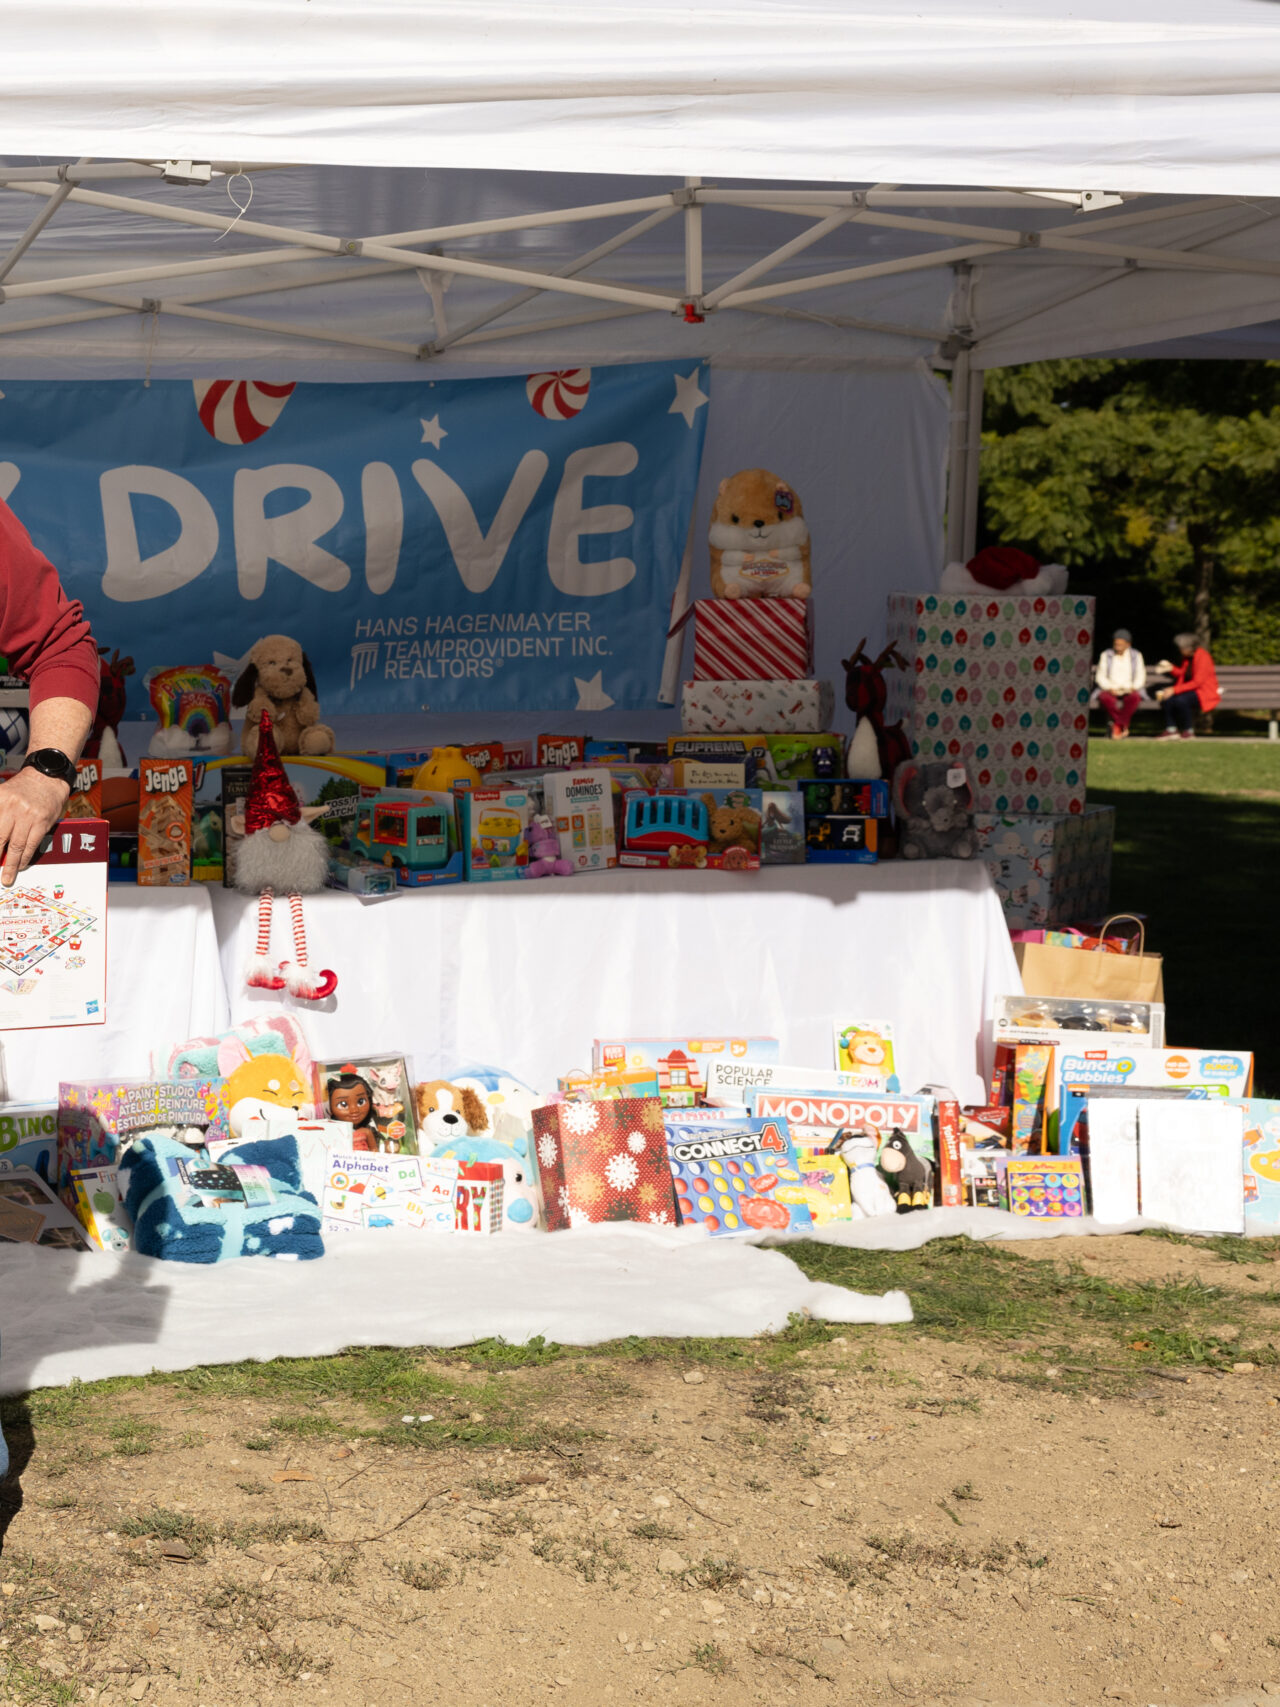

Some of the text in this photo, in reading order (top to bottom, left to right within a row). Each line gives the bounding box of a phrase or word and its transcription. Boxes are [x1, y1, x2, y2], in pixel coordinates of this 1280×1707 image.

[99, 440, 638, 603] DRIVE
[355, 611, 592, 638] HANS HAGENMAYER
[384, 636, 614, 660] TEAMPROVIDENT INC.
[541, 741, 579, 766] Jenga
[674, 741, 745, 752] SUPREME
[145, 764, 187, 792] Jenga
[566, 783, 603, 798] DOMINOES
[715, 1064, 773, 1079] POPULAR
[1063, 1070, 1124, 1084] Bubbles
[717, 1074, 771, 1087] SCIENCE
[127, 1085, 195, 1102] PAINT STUDIO
[119, 1098, 206, 1116] ATELIER PEINTURE
[762, 1096, 918, 1129] MONOPOLY
[117, 1114, 157, 1130] ESTUDIO
[167, 1111, 209, 1124] PINTURA
[674, 1135, 761, 1160] CONNECT
[761, 1125, 783, 1152] 4
[942, 1124, 958, 1161] Yahtzee
[332, 1159, 389, 1174] Alphabet
[398, 1169, 417, 1180] Dd
[432, 1185, 450, 1197] Aa
[405, 1201, 424, 1216] Bb
[436, 1212, 451, 1222] Cc
